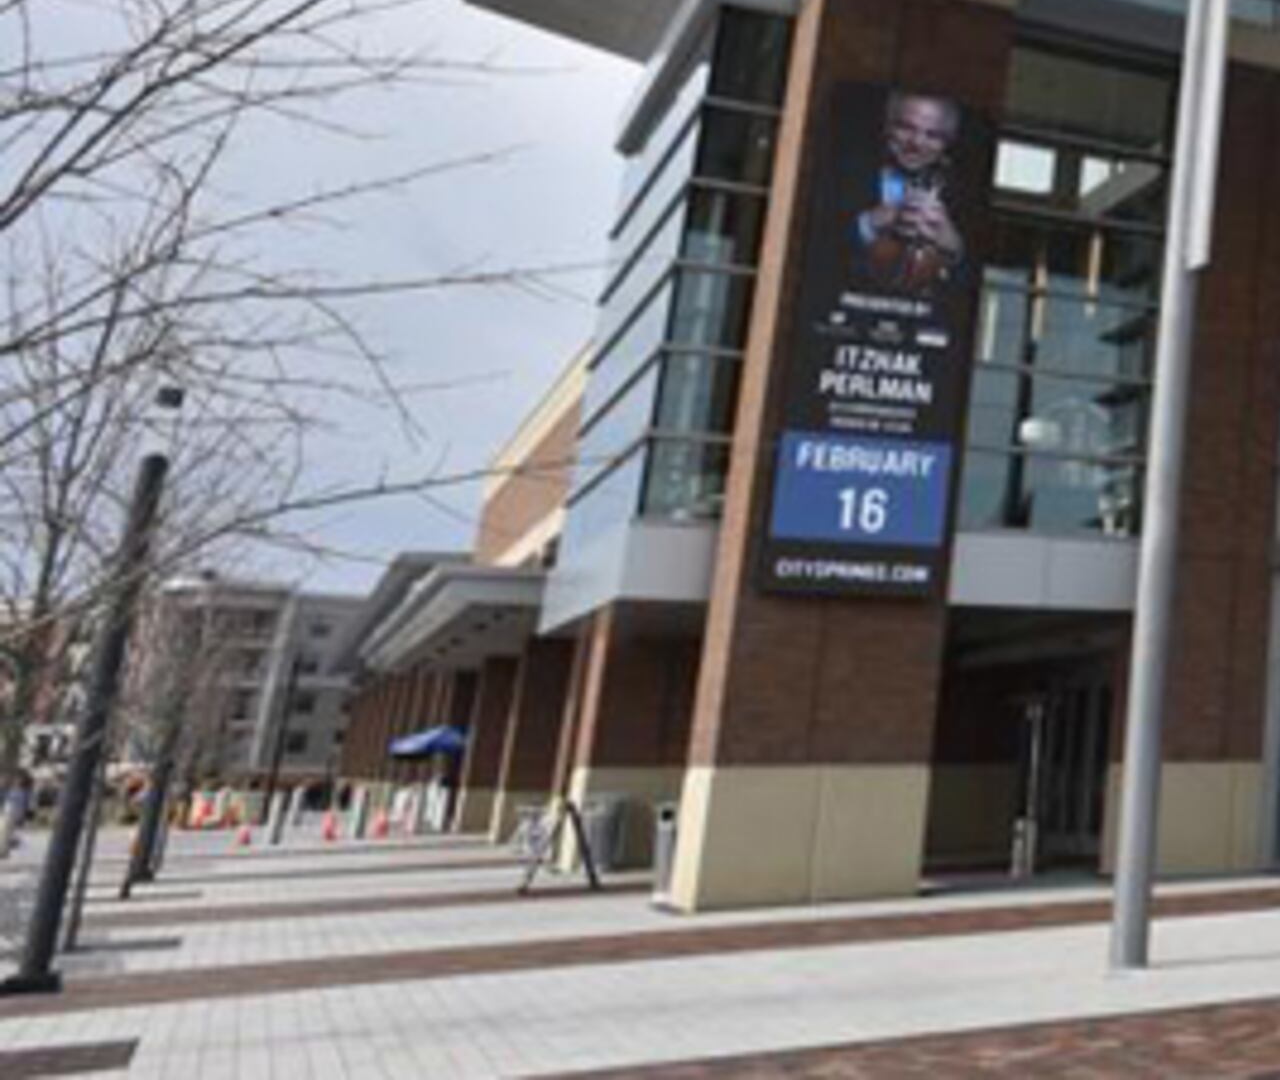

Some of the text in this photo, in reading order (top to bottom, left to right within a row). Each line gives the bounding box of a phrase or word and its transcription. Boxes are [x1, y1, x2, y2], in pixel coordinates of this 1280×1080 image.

[835, 344, 922, 375] ITZHAK
[819, 368, 933, 405] PERLMAN
[795, 440, 936, 477] FEBRUARY
[838, 486, 888, 534] 16
